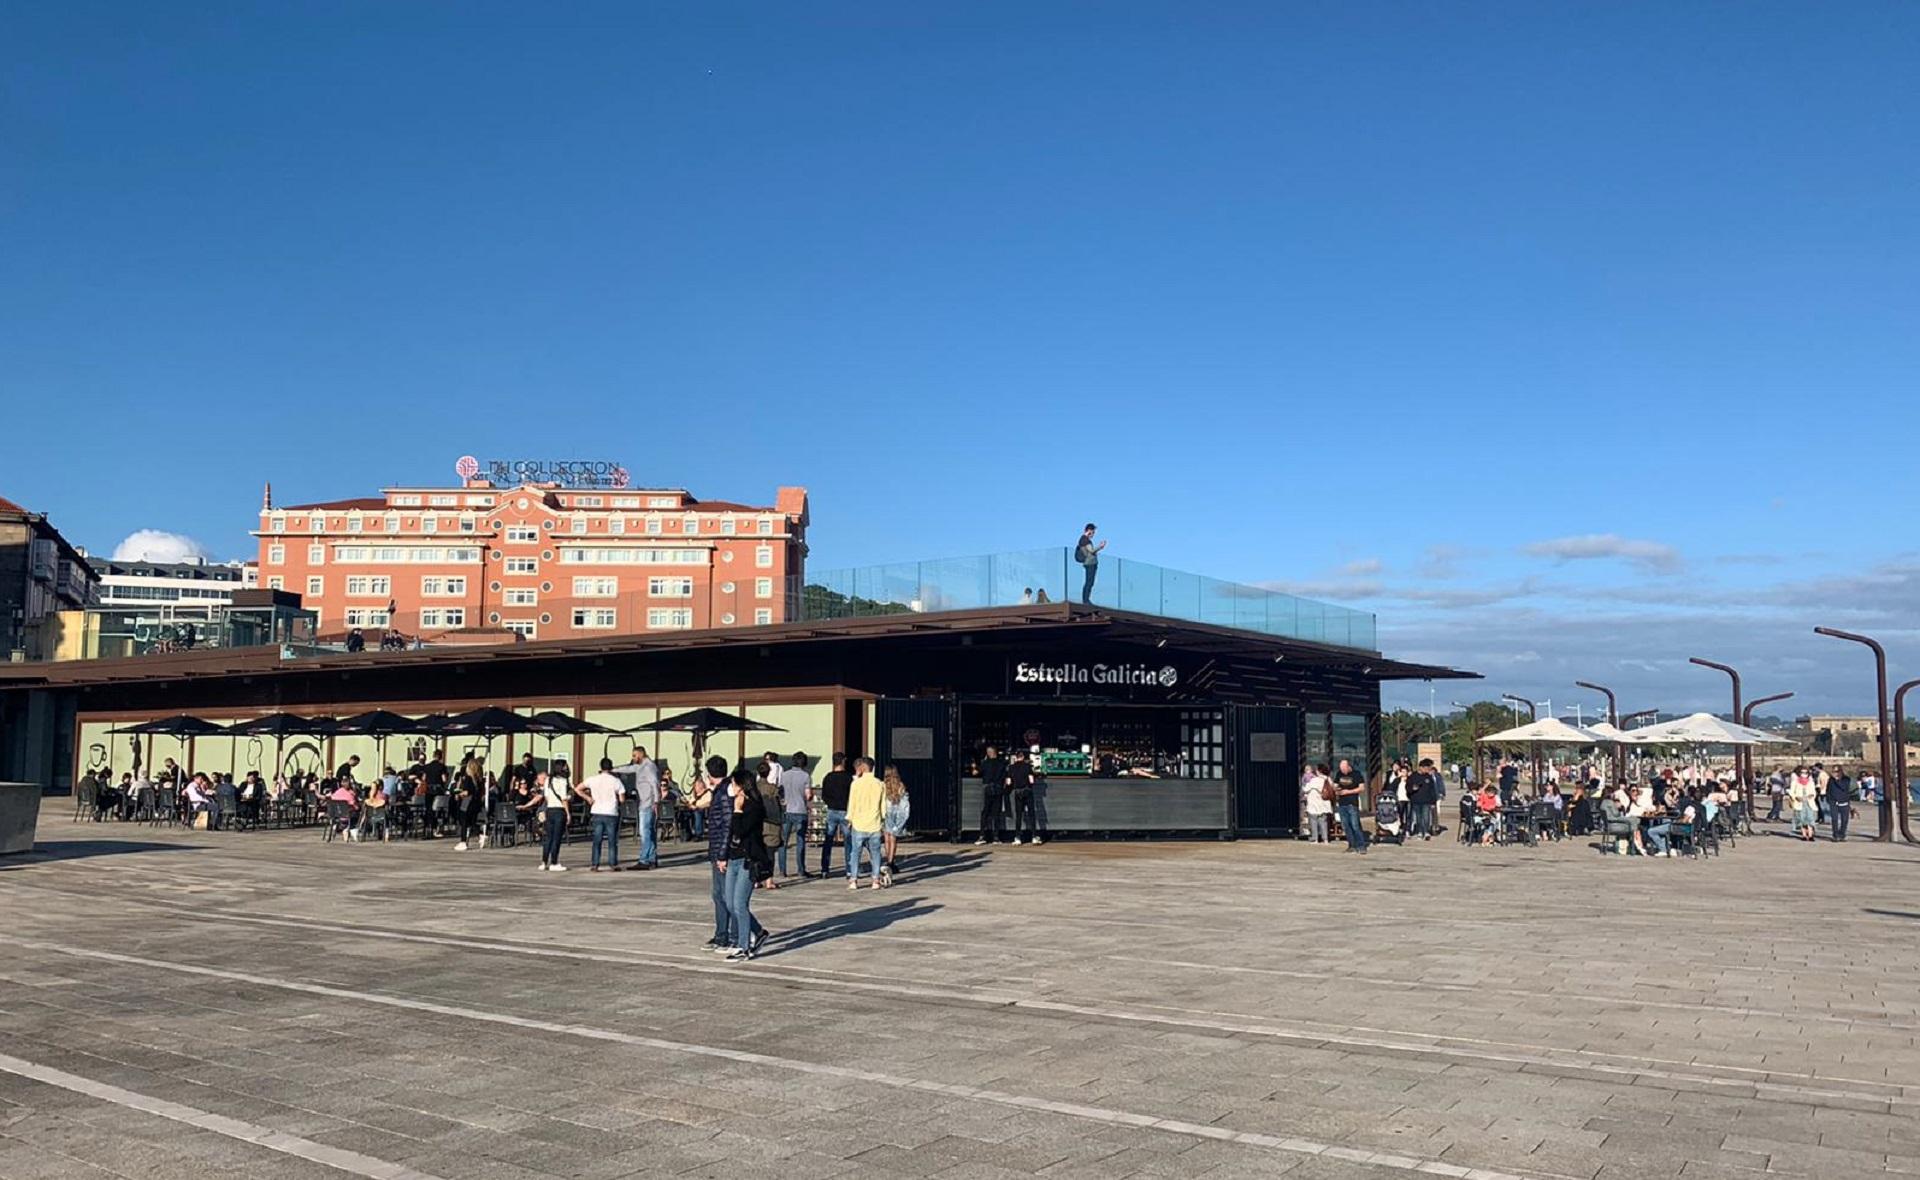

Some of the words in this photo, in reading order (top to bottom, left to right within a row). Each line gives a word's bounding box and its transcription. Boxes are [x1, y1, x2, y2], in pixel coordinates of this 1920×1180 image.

[514, 461, 620, 474] COLLECTION
[1015, 662, 1088, 683] Estrella
[1091, 663, 1158, 685] Galicia
